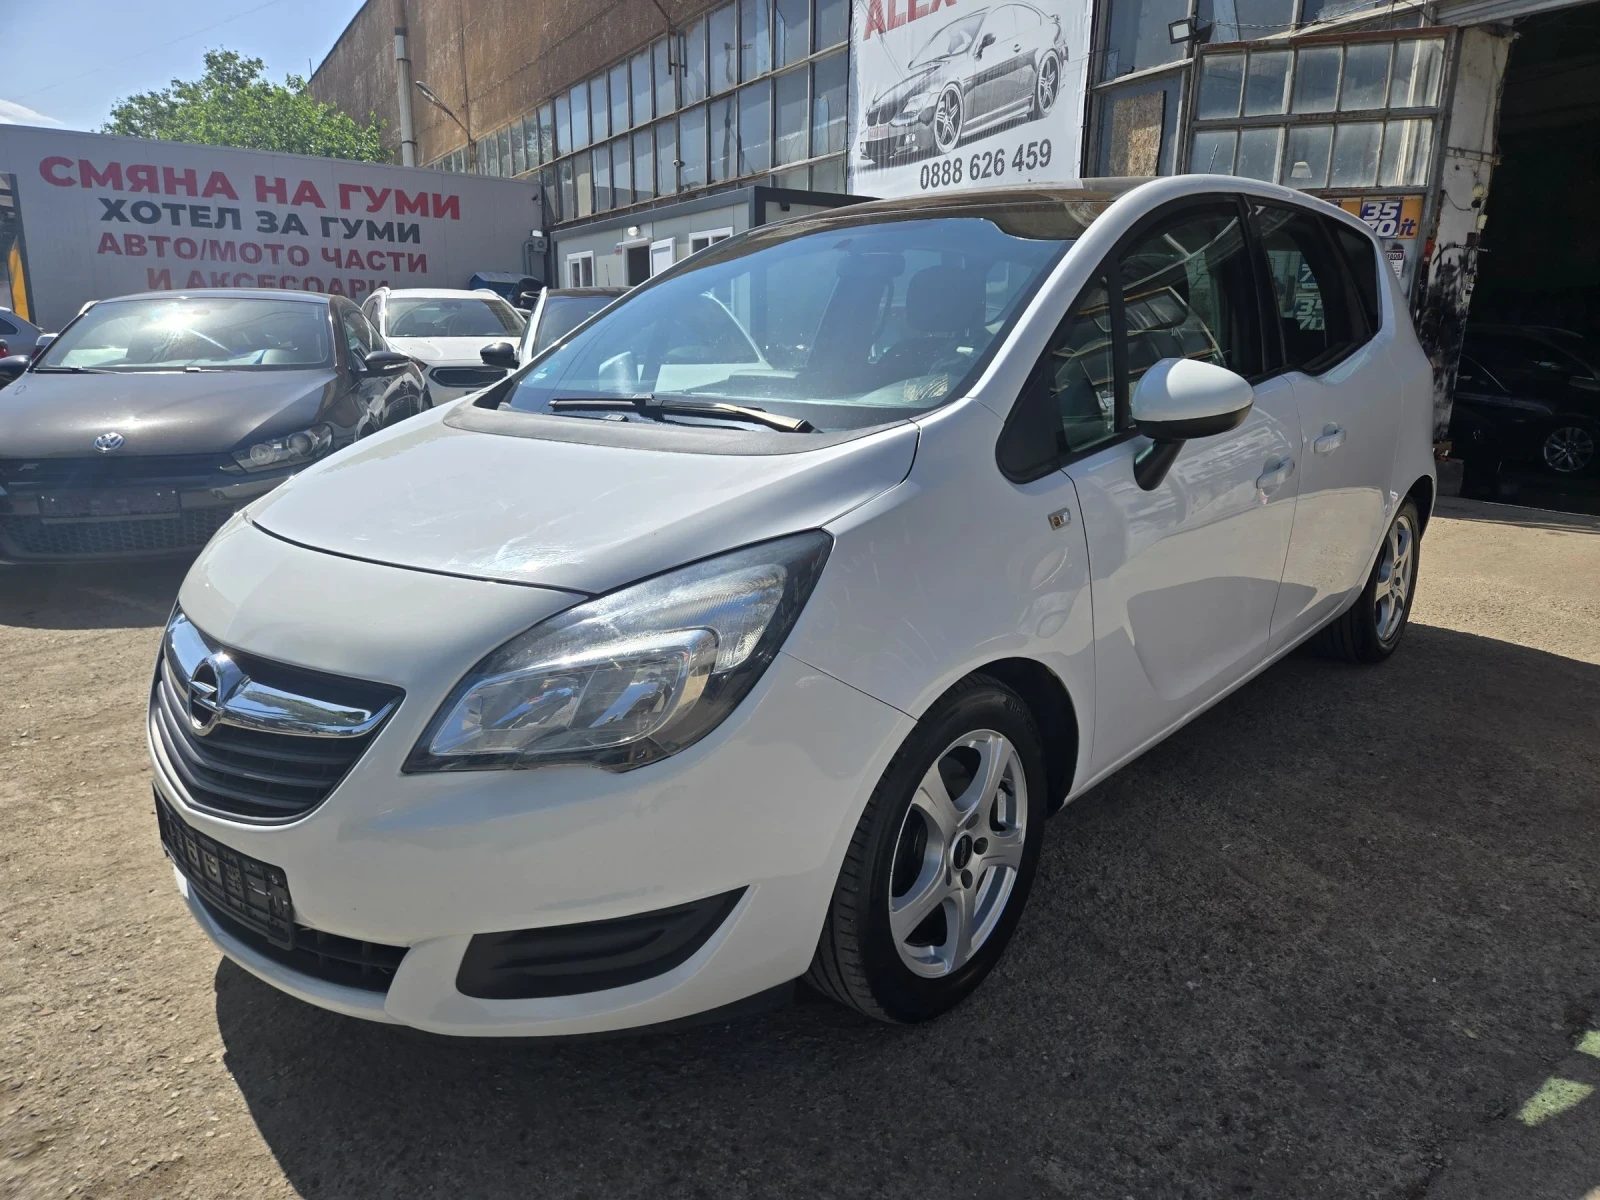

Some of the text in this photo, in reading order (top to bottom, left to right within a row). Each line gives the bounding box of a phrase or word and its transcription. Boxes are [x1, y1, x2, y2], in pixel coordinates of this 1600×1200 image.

[920, 138, 1052, 190] 0888 626 459
[39, 156, 460, 221] СМЯНА НА ГУМИ
[1363, 202, 1400, 219] 35
[99, 197, 421, 244] ХОТЕЛ ЗА ГУМИ
[97, 232, 427, 273] АВТО/МОТО ЧАСТИ
[147, 267, 172, 290] И
